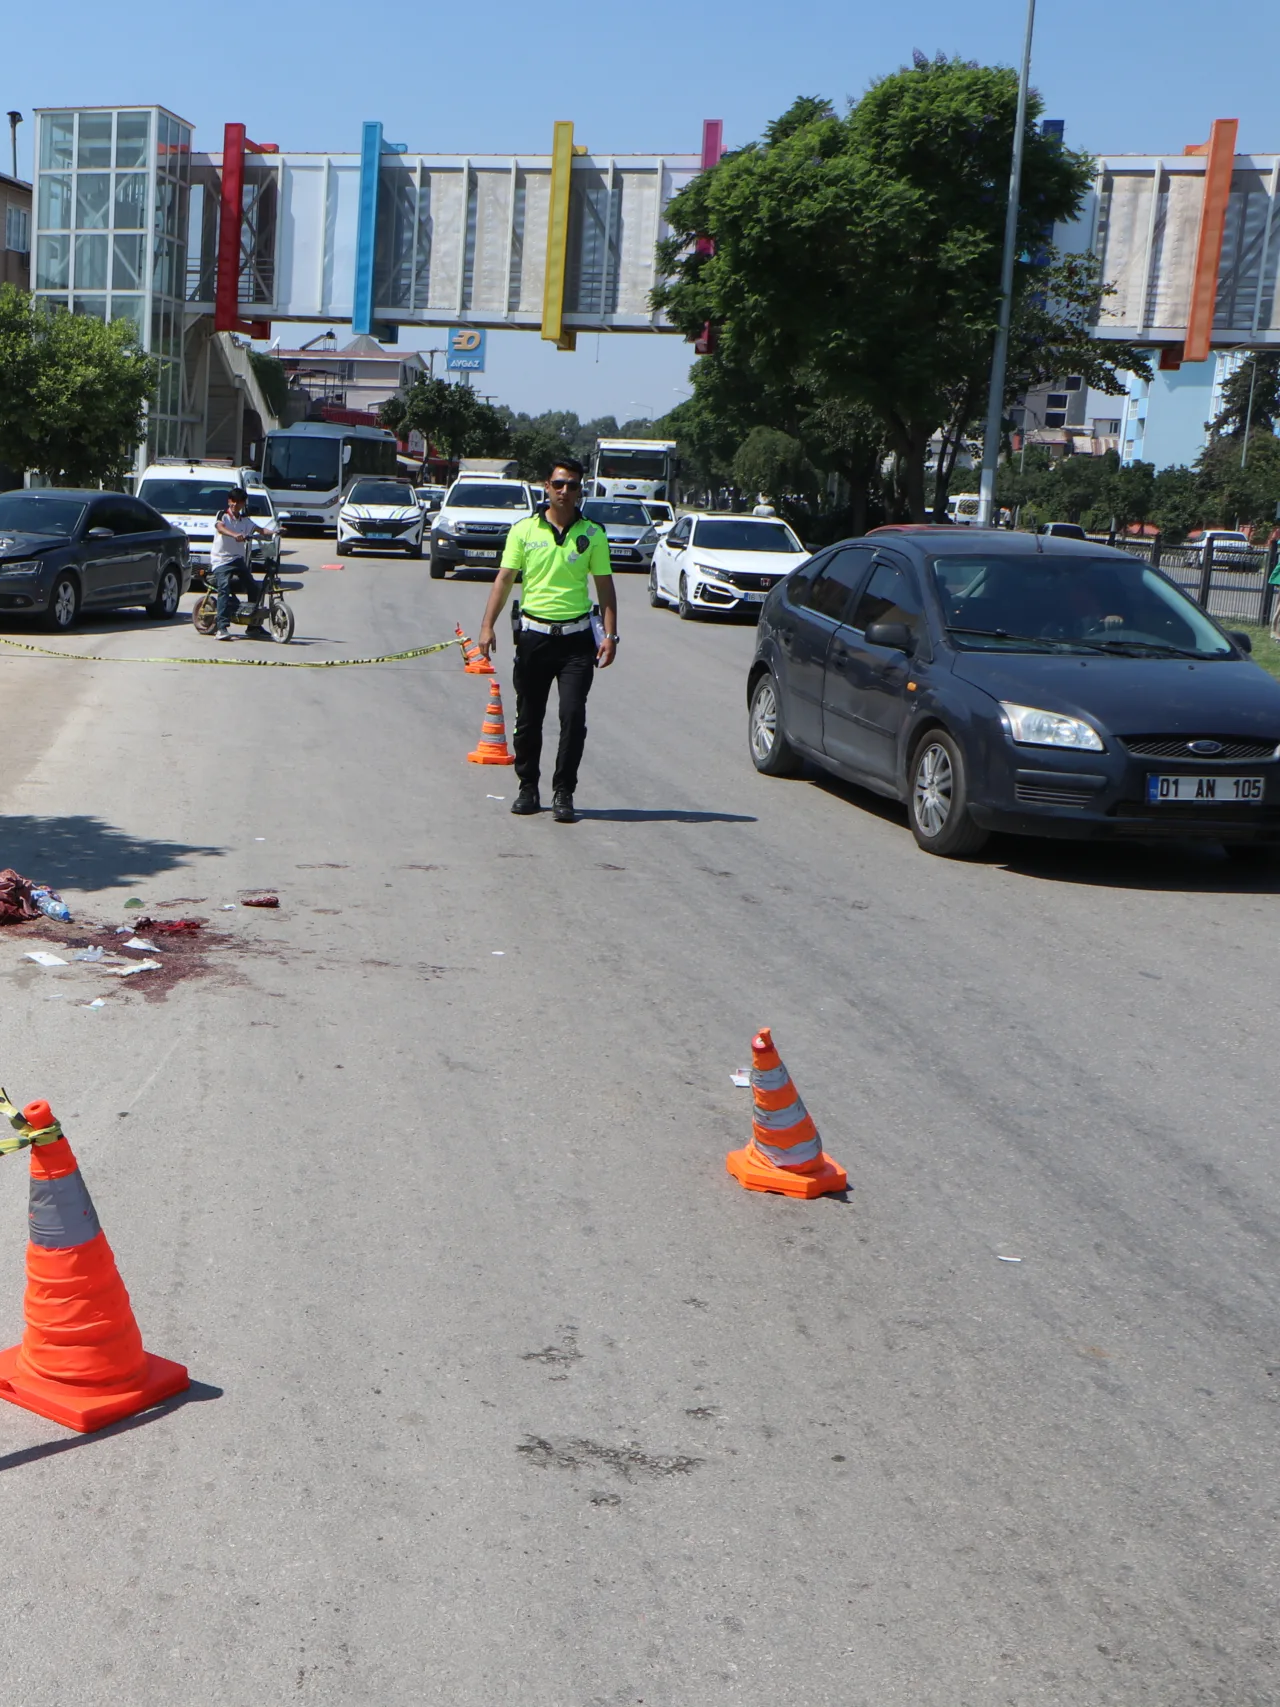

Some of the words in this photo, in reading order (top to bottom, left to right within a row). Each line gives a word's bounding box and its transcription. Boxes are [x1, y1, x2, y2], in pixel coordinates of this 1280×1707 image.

[450, 359, 480, 368] AYGAZ
[1160, 778, 1179, 798] 01
[1195, 778, 1216, 798] AN
[1233, 779, 1261, 798] 105
